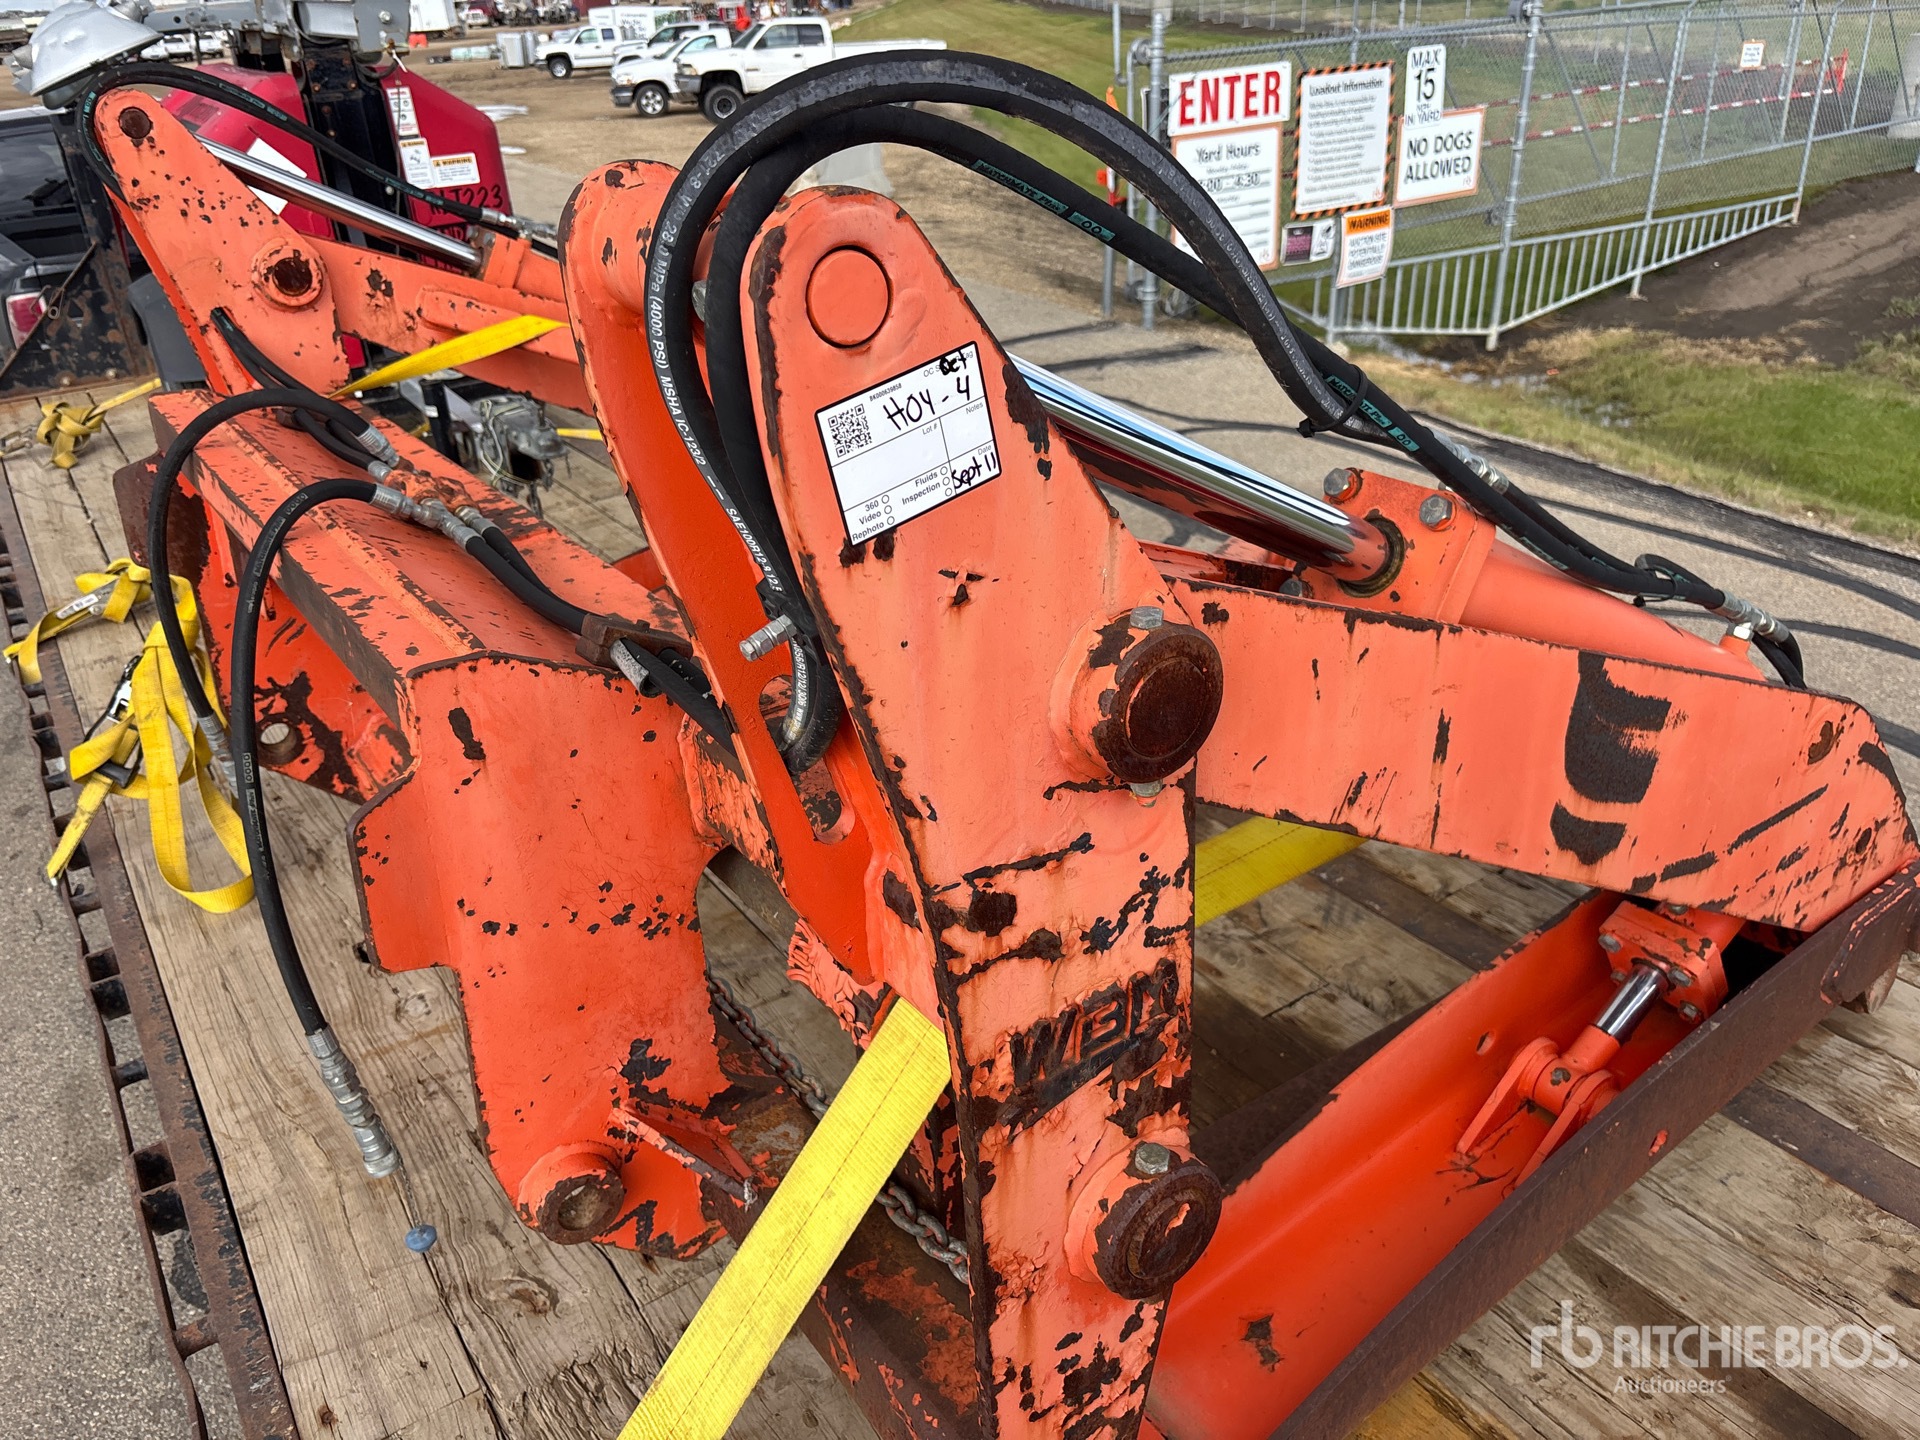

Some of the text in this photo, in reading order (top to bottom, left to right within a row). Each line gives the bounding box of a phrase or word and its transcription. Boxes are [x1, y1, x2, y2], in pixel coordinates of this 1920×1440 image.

[1411, 49, 1442, 69] MAX
[1413, 68, 1436, 102] 15
[1179, 70, 1281, 127] ENTER
[1405, 110, 1442, 125] IN YARD
[1196, 143, 1261, 163] Yard Hours
[1407, 130, 1474, 159] NO DOGS
[1403, 156, 1472, 185] ALLOWED
[1350, 214, 1389, 229] WARNING
[650, 258, 668, 292] MPa
[650, 296, 664, 338] (4000
[652, 339, 669, 370] PSI)
[922, 367, 935, 378] OC
[660, 375, 682, 416] MSHA
[956, 375, 970, 401] 4
[965, 401, 984, 415] Notes
[922, 425, 933, 436] Lot
[675, 418, 707, 466] IC-123/2
[977, 444, 992, 457] Date
[914, 469, 938, 488] Fluids
[951, 456, 982, 490] Sept
[902, 482, 941, 506] Inspection
[865, 500, 880, 513] 360
[858, 510, 882, 526] Video
[851, 521, 885, 542] Rephoto
